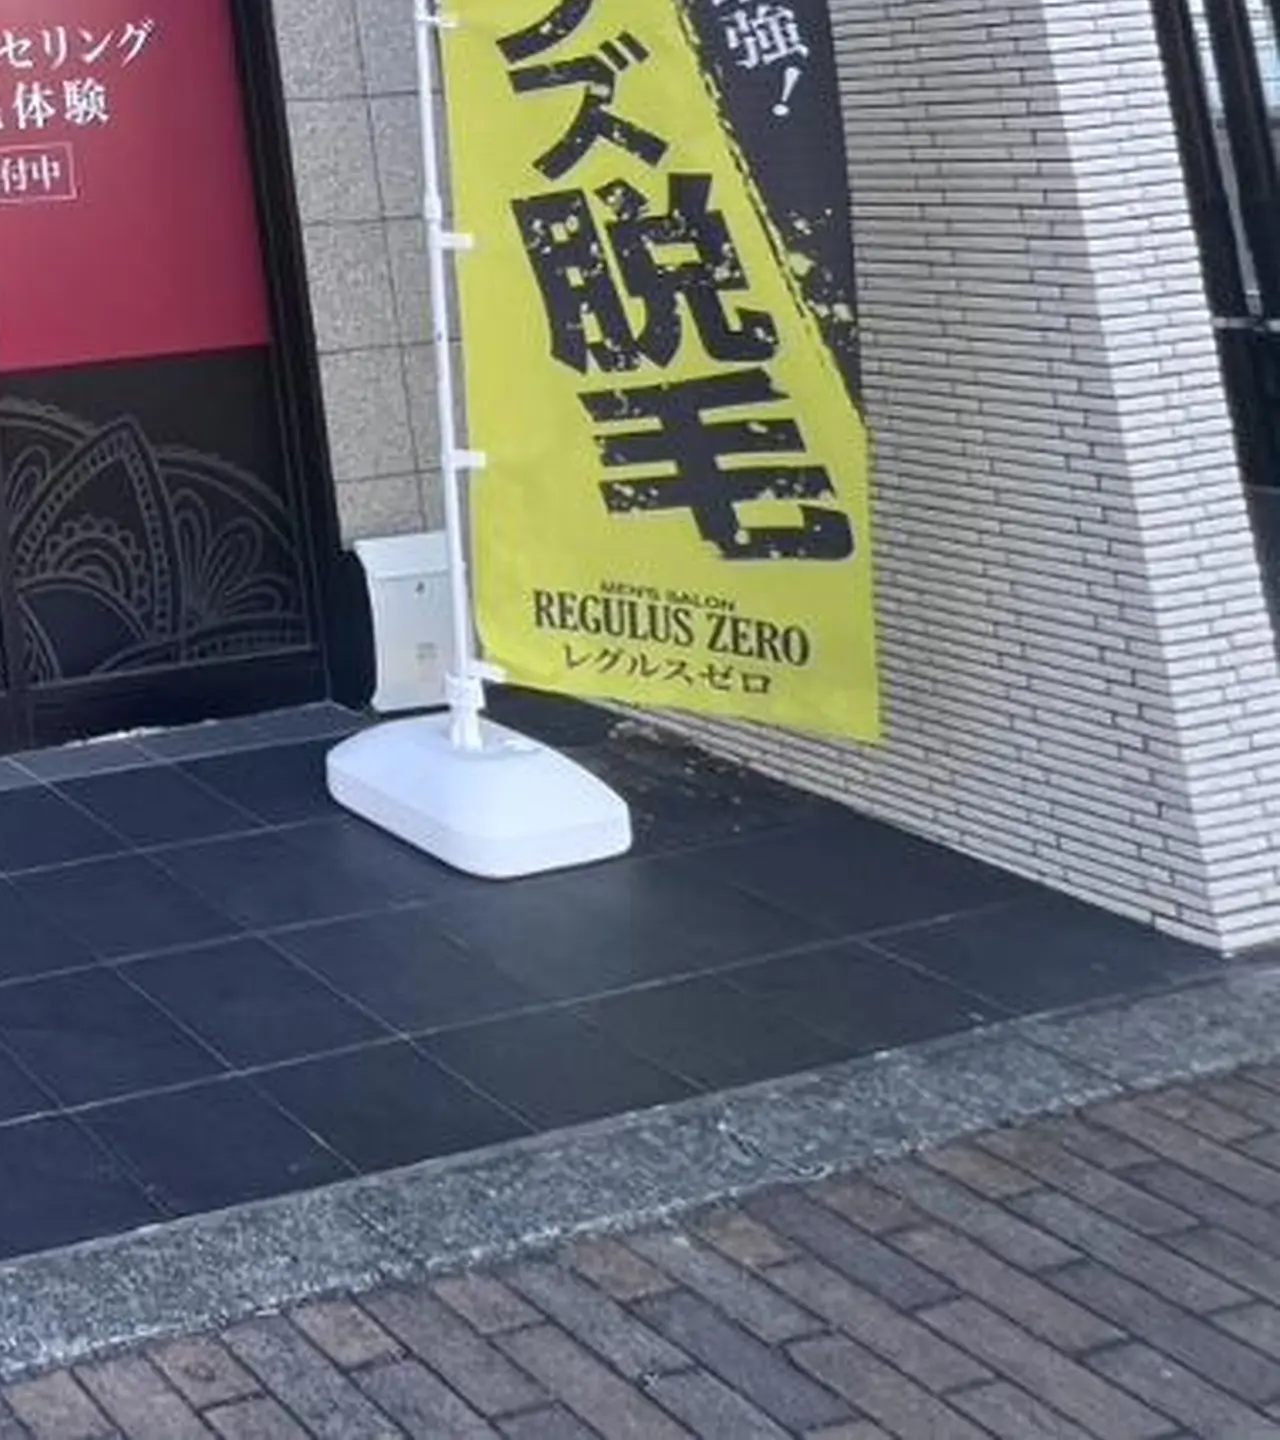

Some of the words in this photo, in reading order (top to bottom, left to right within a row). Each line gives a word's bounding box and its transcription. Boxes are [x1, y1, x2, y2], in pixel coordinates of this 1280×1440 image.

[533, 588, 696, 648] REGULUS
[705, 610, 812, 668] ZERO
[563, 642, 771, 695] レグルスゼロ
